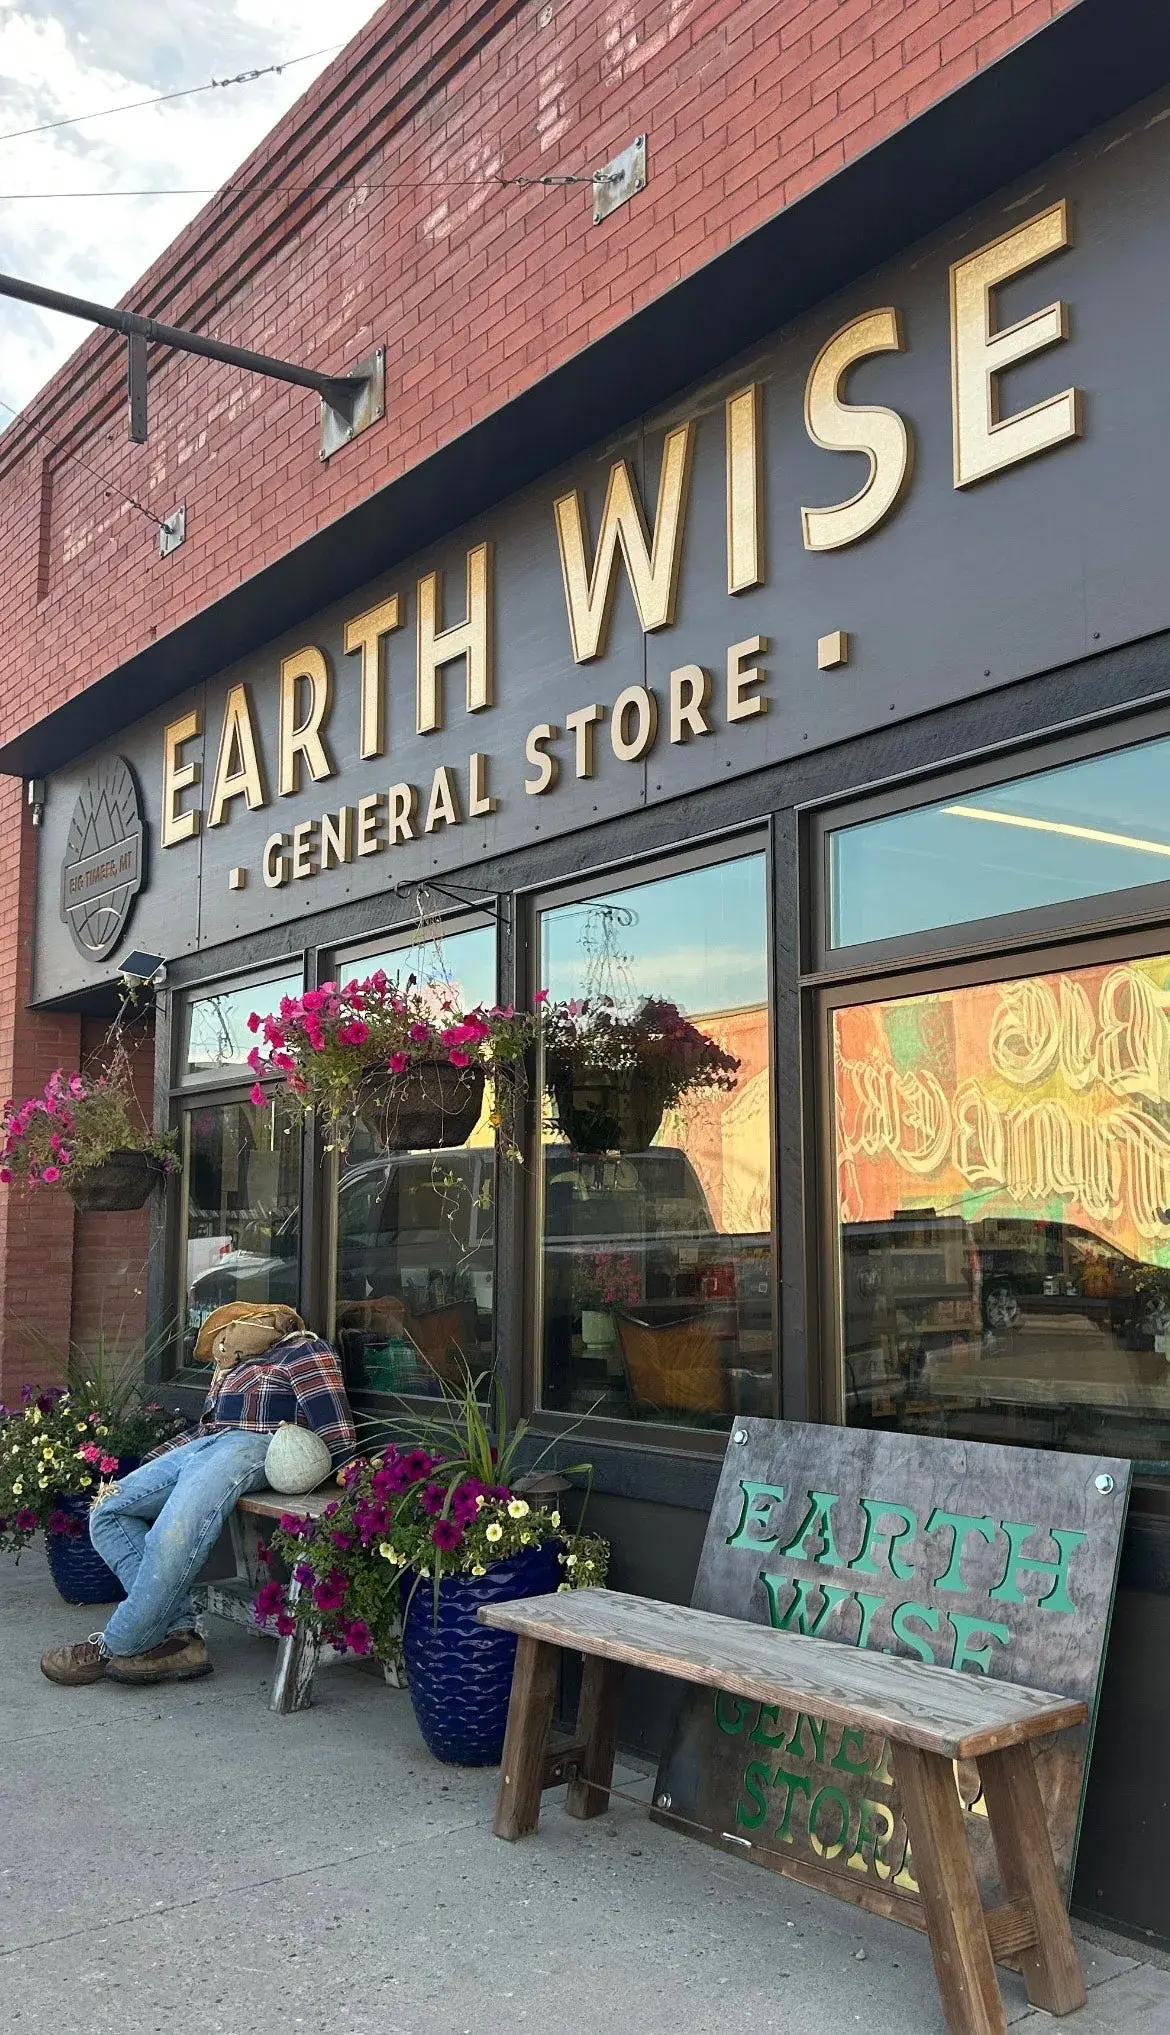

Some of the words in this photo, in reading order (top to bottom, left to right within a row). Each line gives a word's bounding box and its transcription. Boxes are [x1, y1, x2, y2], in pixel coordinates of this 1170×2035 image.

[161, 541, 495, 849] EARTH
[553, 198, 1084, 665] WISE
[263, 752, 497, 888] GENERAL
[523, 635, 769, 796] STORE
[69, 874, 84, 894] BIG
[120, 850, 133, 873] MT
[726, 1479, 1088, 1614] EARTH
[759, 1571, 1010, 1675] WISE
